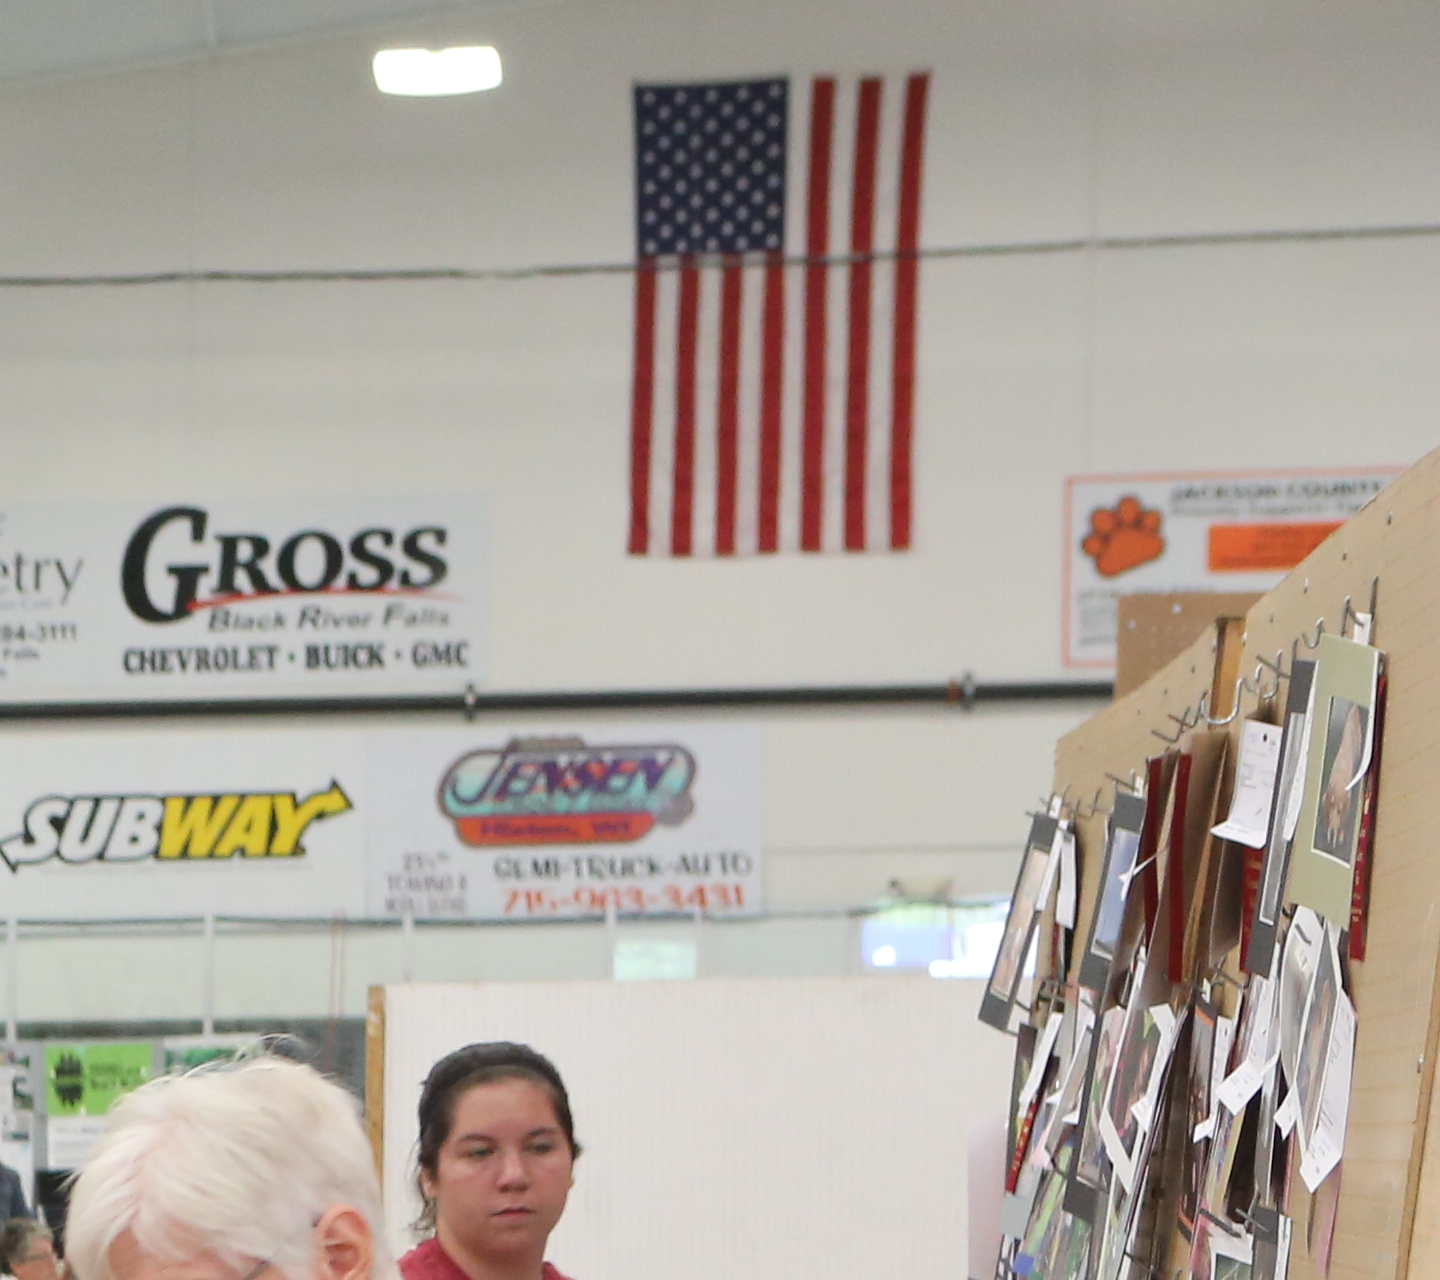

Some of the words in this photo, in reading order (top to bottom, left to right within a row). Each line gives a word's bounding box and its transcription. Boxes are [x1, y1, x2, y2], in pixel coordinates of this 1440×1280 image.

[121, 505, 449, 626] GROSS
[208, 604, 286, 632] Black
[297, 604, 375, 631] River
[383, 602, 449, 628] Falls
[123, 645, 279, 674] CHEVROLET
[304, 643, 385, 670] BUICK
[411, 640, 470, 669] GMC
